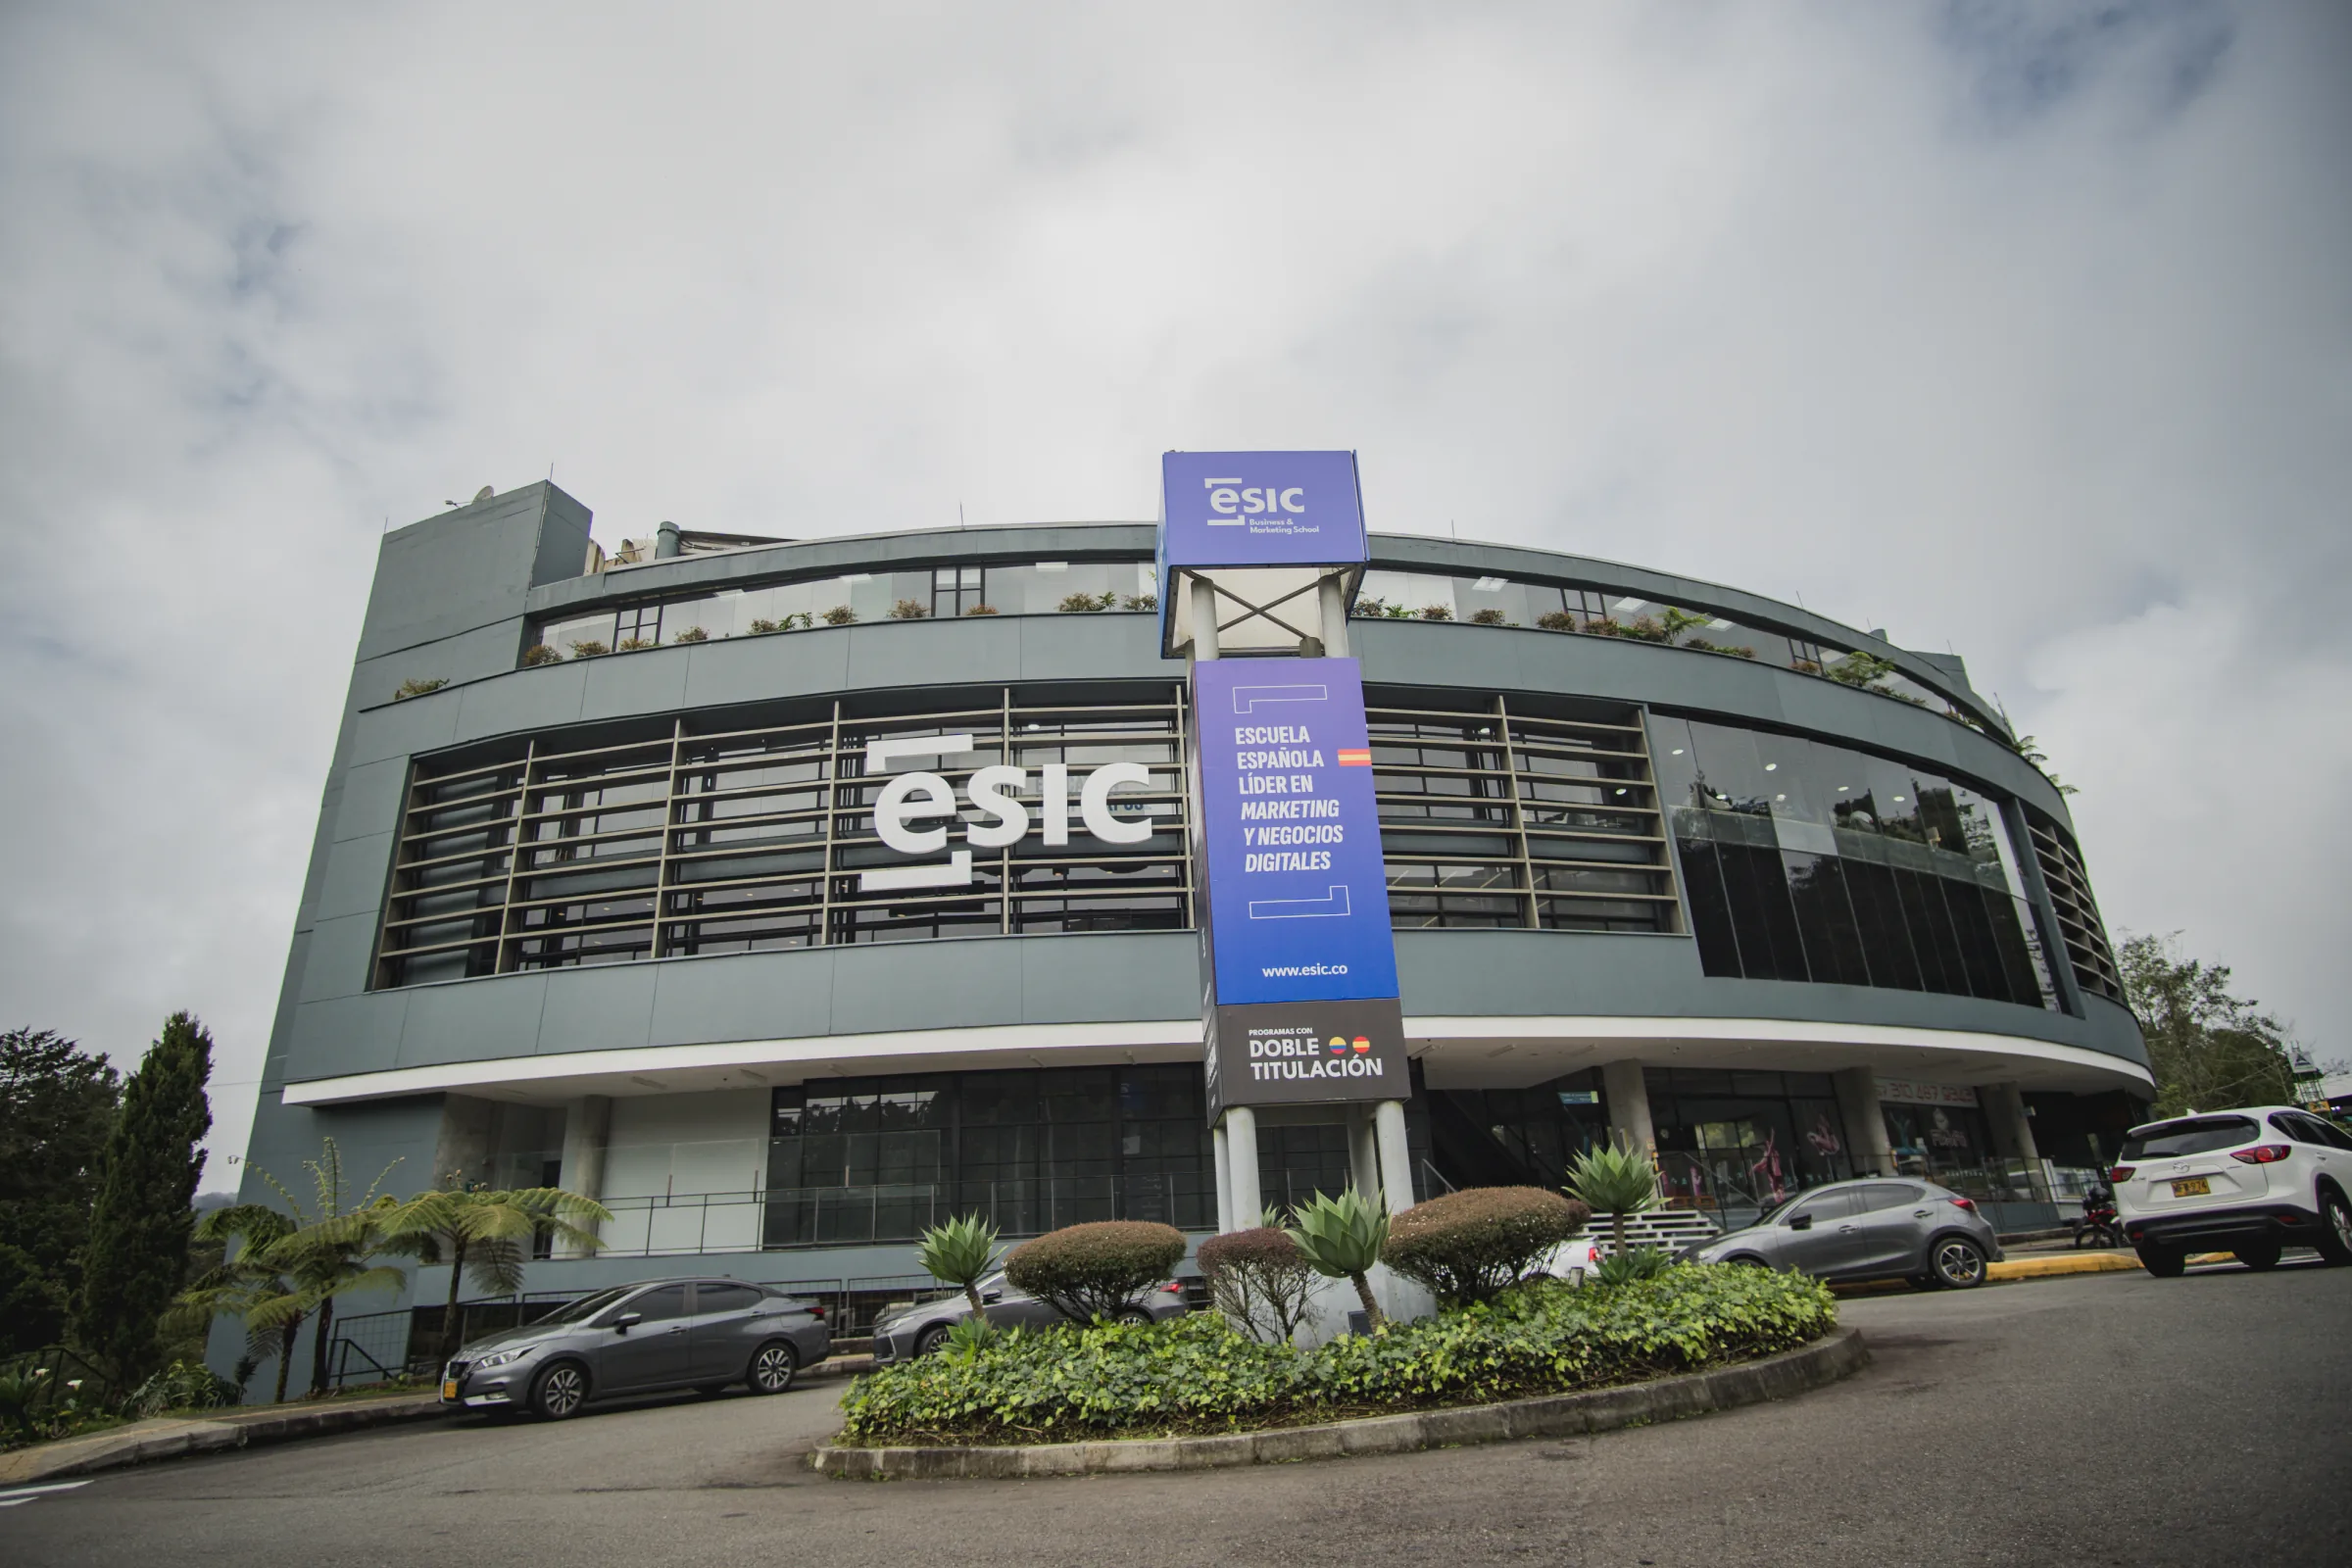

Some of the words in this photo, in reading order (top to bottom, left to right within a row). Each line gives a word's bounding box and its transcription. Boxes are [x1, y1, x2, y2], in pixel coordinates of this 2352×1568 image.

[1235, 725, 1311, 745] ESCUELA
[1237, 747, 1324, 769] ESPAÑOLA
[1239, 771, 1288, 795] LÍDER
[1290, 774, 1313, 793] EN
[1241, 799, 1340, 820] MARKETING
[1244, 827, 1255, 846] Y
[1257, 824, 1344, 846] NEGOCIOS
[1245, 851, 1332, 872] DIGITALES
[1262, 962, 1348, 977] www.esic.co
[1250, 1038, 1320, 1057] DOBLE
[1250, 1054, 1383, 1080] TITULACIÓN
